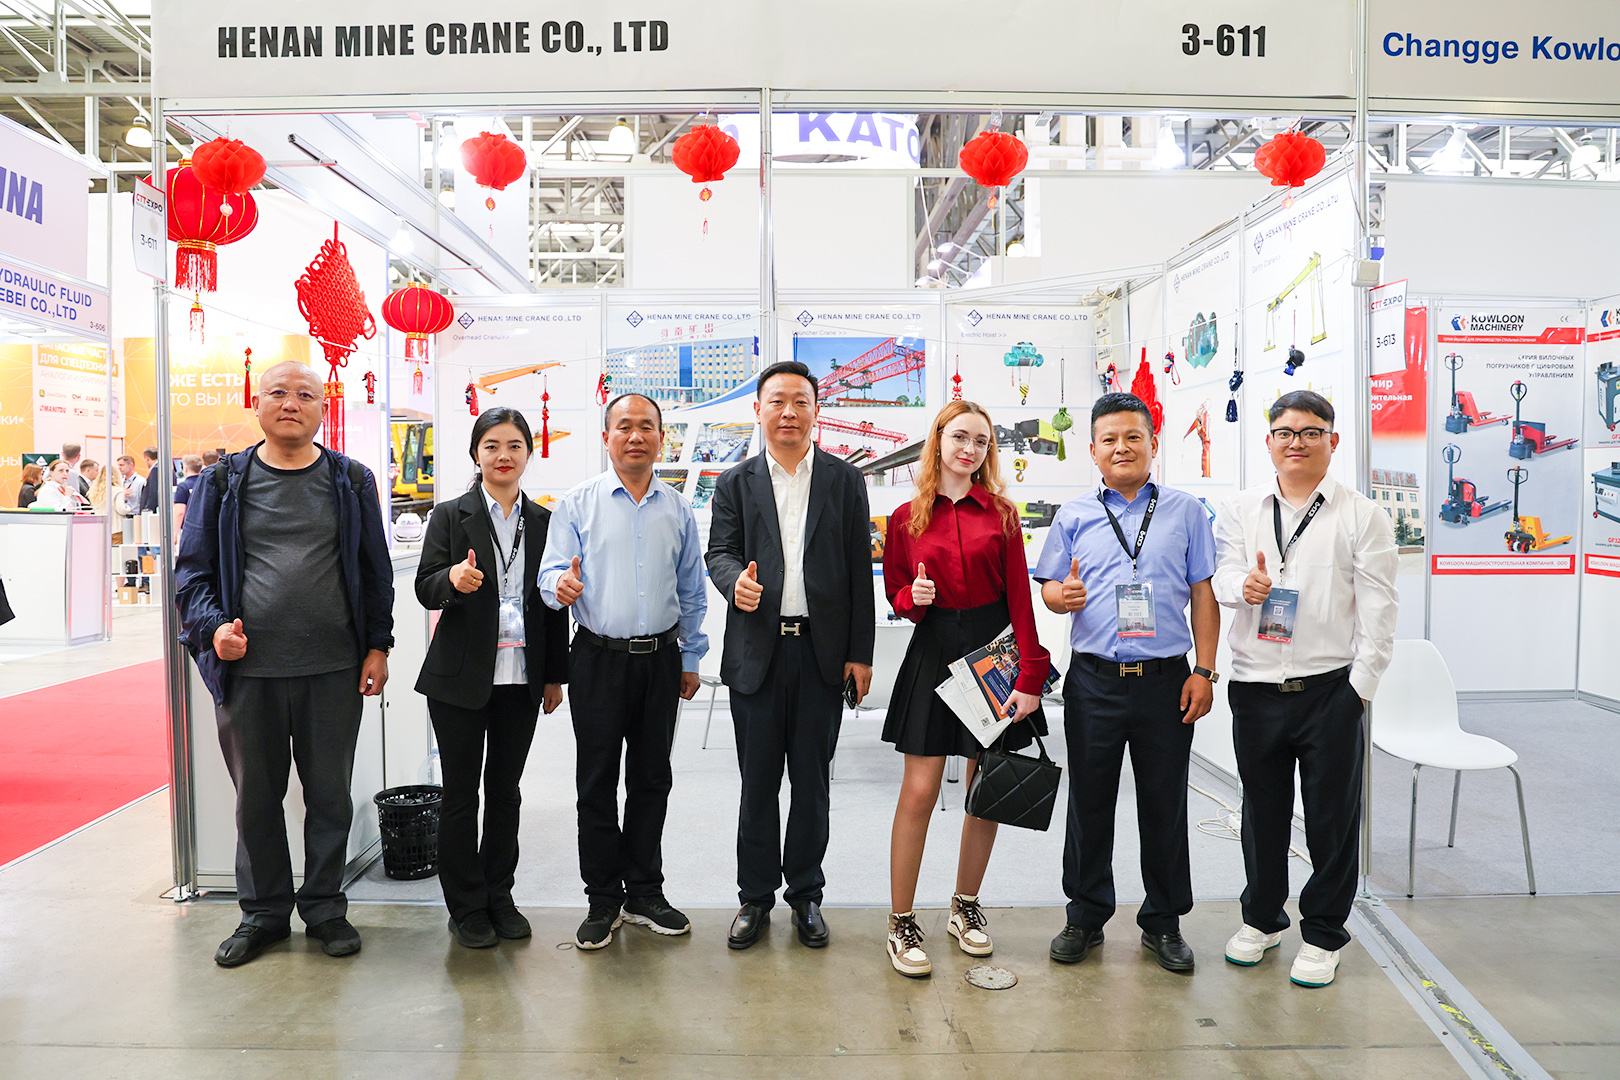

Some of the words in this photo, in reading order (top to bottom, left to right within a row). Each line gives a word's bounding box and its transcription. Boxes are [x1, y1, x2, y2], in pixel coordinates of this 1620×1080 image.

[218, 26, 322, 58] HENAN
[335, 24, 414, 57] MINE
[425, 21, 529, 56] CRANE
[541, 20, 602, 57] CO.,
[613, 20, 669, 53] LTD
[1181, 23, 1267, 57] 3-611
[1383, 31, 1519, 65] Changge
[799, 113, 921, 165] KATO
[136, 193, 147, 204] CTT
[146, 199, 163, 212] EXPO
[140, 234, 157, 250] 3-611
[60, 287, 92, 307] FLUID
[1371, 300, 1382, 310] CTT
[1383, 295, 1402, 306] EXPO
[31, 297, 77, 320] CO.,LTD
[90, 321, 105, 332] 3-606
[1471, 314, 1524, 324] KOWLOON
[1470, 324, 1524, 332] MACHINERY
[1376, 334, 1396, 348] 3-613
[86, 347, 107, 358] ЧАСТ
[40, 353, 59, 364] ДЛЯ
[60, 356, 117, 374] СПЕЦТЕХНИИ
[170, 373, 196, 387] ЖЕ
[201, 373, 245, 387] ЕСТЬ
[170, 393, 190, 406] ТО
[196, 393, 220, 406] ВЫ
[0, 456, 21, 467] НЫ
